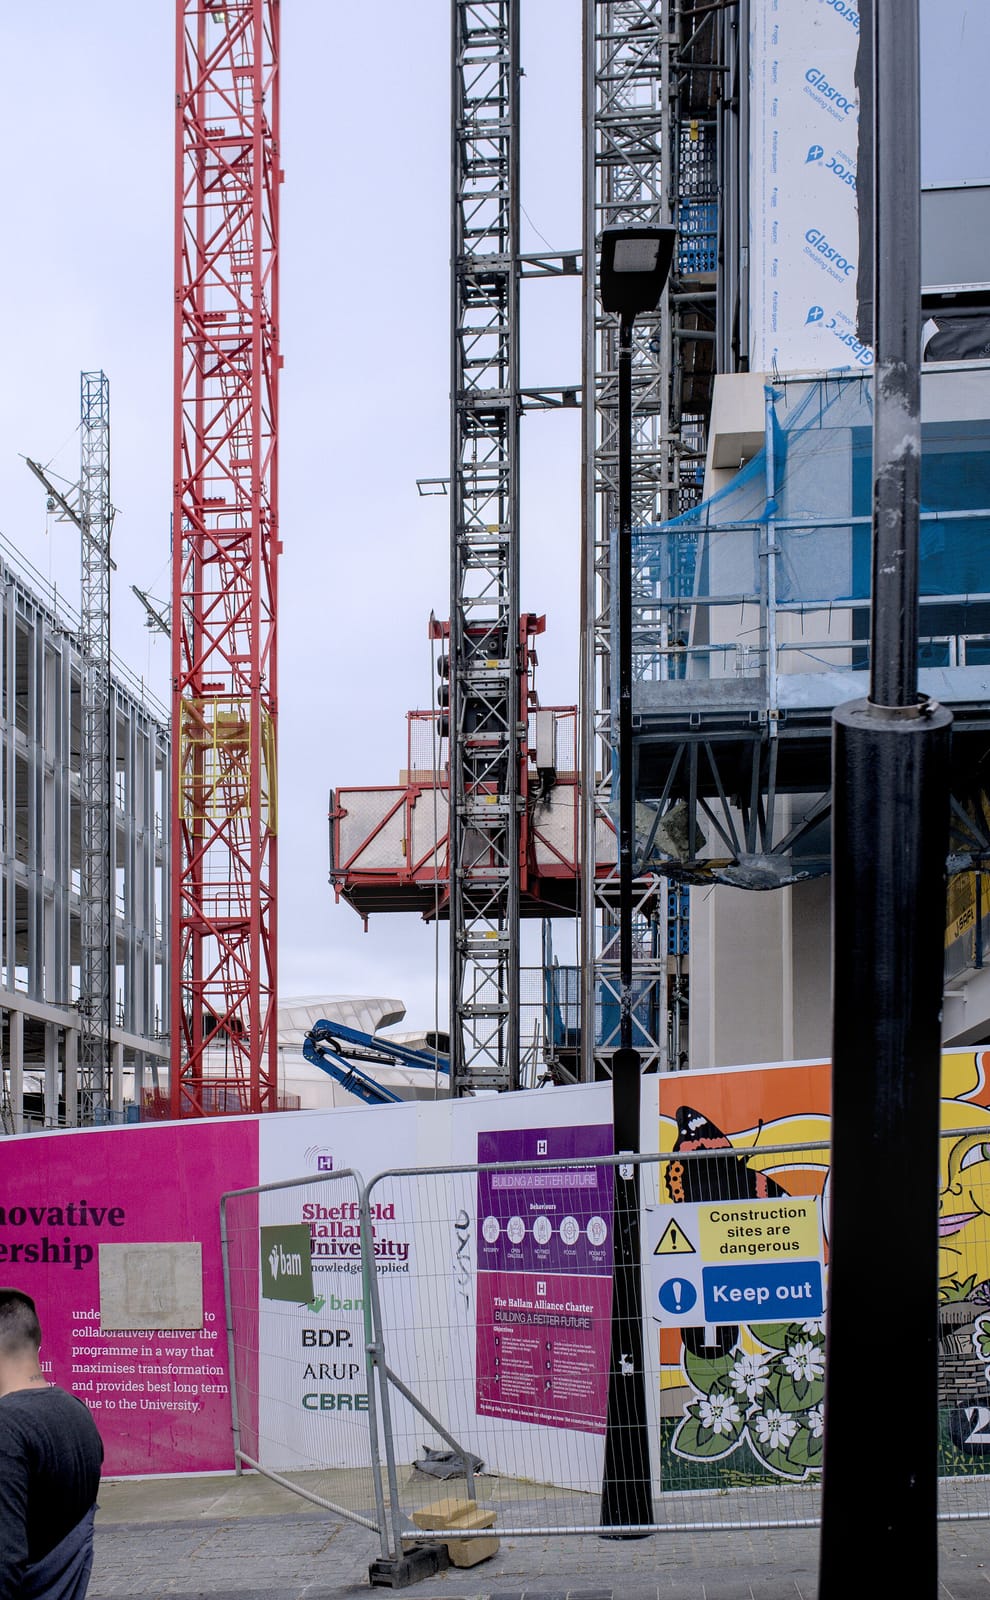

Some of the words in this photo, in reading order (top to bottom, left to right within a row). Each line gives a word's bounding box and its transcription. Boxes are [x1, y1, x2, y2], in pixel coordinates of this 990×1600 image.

[804, 68, 855, 115] Glasroc
[804, 228, 855, 276] Glasroc
[534, 1175, 564, 1186] BETTER
[564, 1174, 596, 1186] FUTURE
[302, 1203, 395, 1220] Sheffeld
[709, 1208, 807, 1223] Construction
[727, 1227, 763, 1238] sites
[766, 1225, 791, 1236] are
[719, 1240, 800, 1256] dangerous
[280, 1244, 302, 1276] bam
[312, 1262, 363, 1275] nowledge
[712, 1284, 770, 1305] Keep
[775, 1281, 813, 1298] out
[494, 1297, 507, 1307] The
[508, 1298, 533, 1309] Hallam
[534, 1300, 565, 1311] Alliance
[565, 1302, 594, 1313] Charter
[204, 1311, 216, 1321] to
[561, 1316, 590, 1329] FUTURE
[72, 1326, 155, 1340] collaboratively
[199, 1329, 218, 1339] the
[302, 1329, 353, 1348] BDP.
[72, 1346, 138, 1358] programme
[141, 1345, 153, 1356] in
[155, 1348, 162, 1357] a
[165, 1348, 188, 1358] way
[191, 1346, 215, 1358] that
[40, 1361, 52, 1372] ill
[72, 1362, 136, 1374] maximises
[138, 1363, 225, 1376] transformation
[303, 1363, 360, 1380] ARUP
[72, 1380, 93, 1391] and
[96, 1380, 144, 1393] provides
[147, 1380, 171, 1392] best
[173, 1382, 199, 1394] long
[201, 1383, 229, 1393] term
[83, 1399, 103, 1409] lue
[105, 1399, 116, 1409] to
[118, 1399, 137, 1410] the
[140, 1399, 201, 1411] University.
[302, 1393, 369, 1411] CBRE
